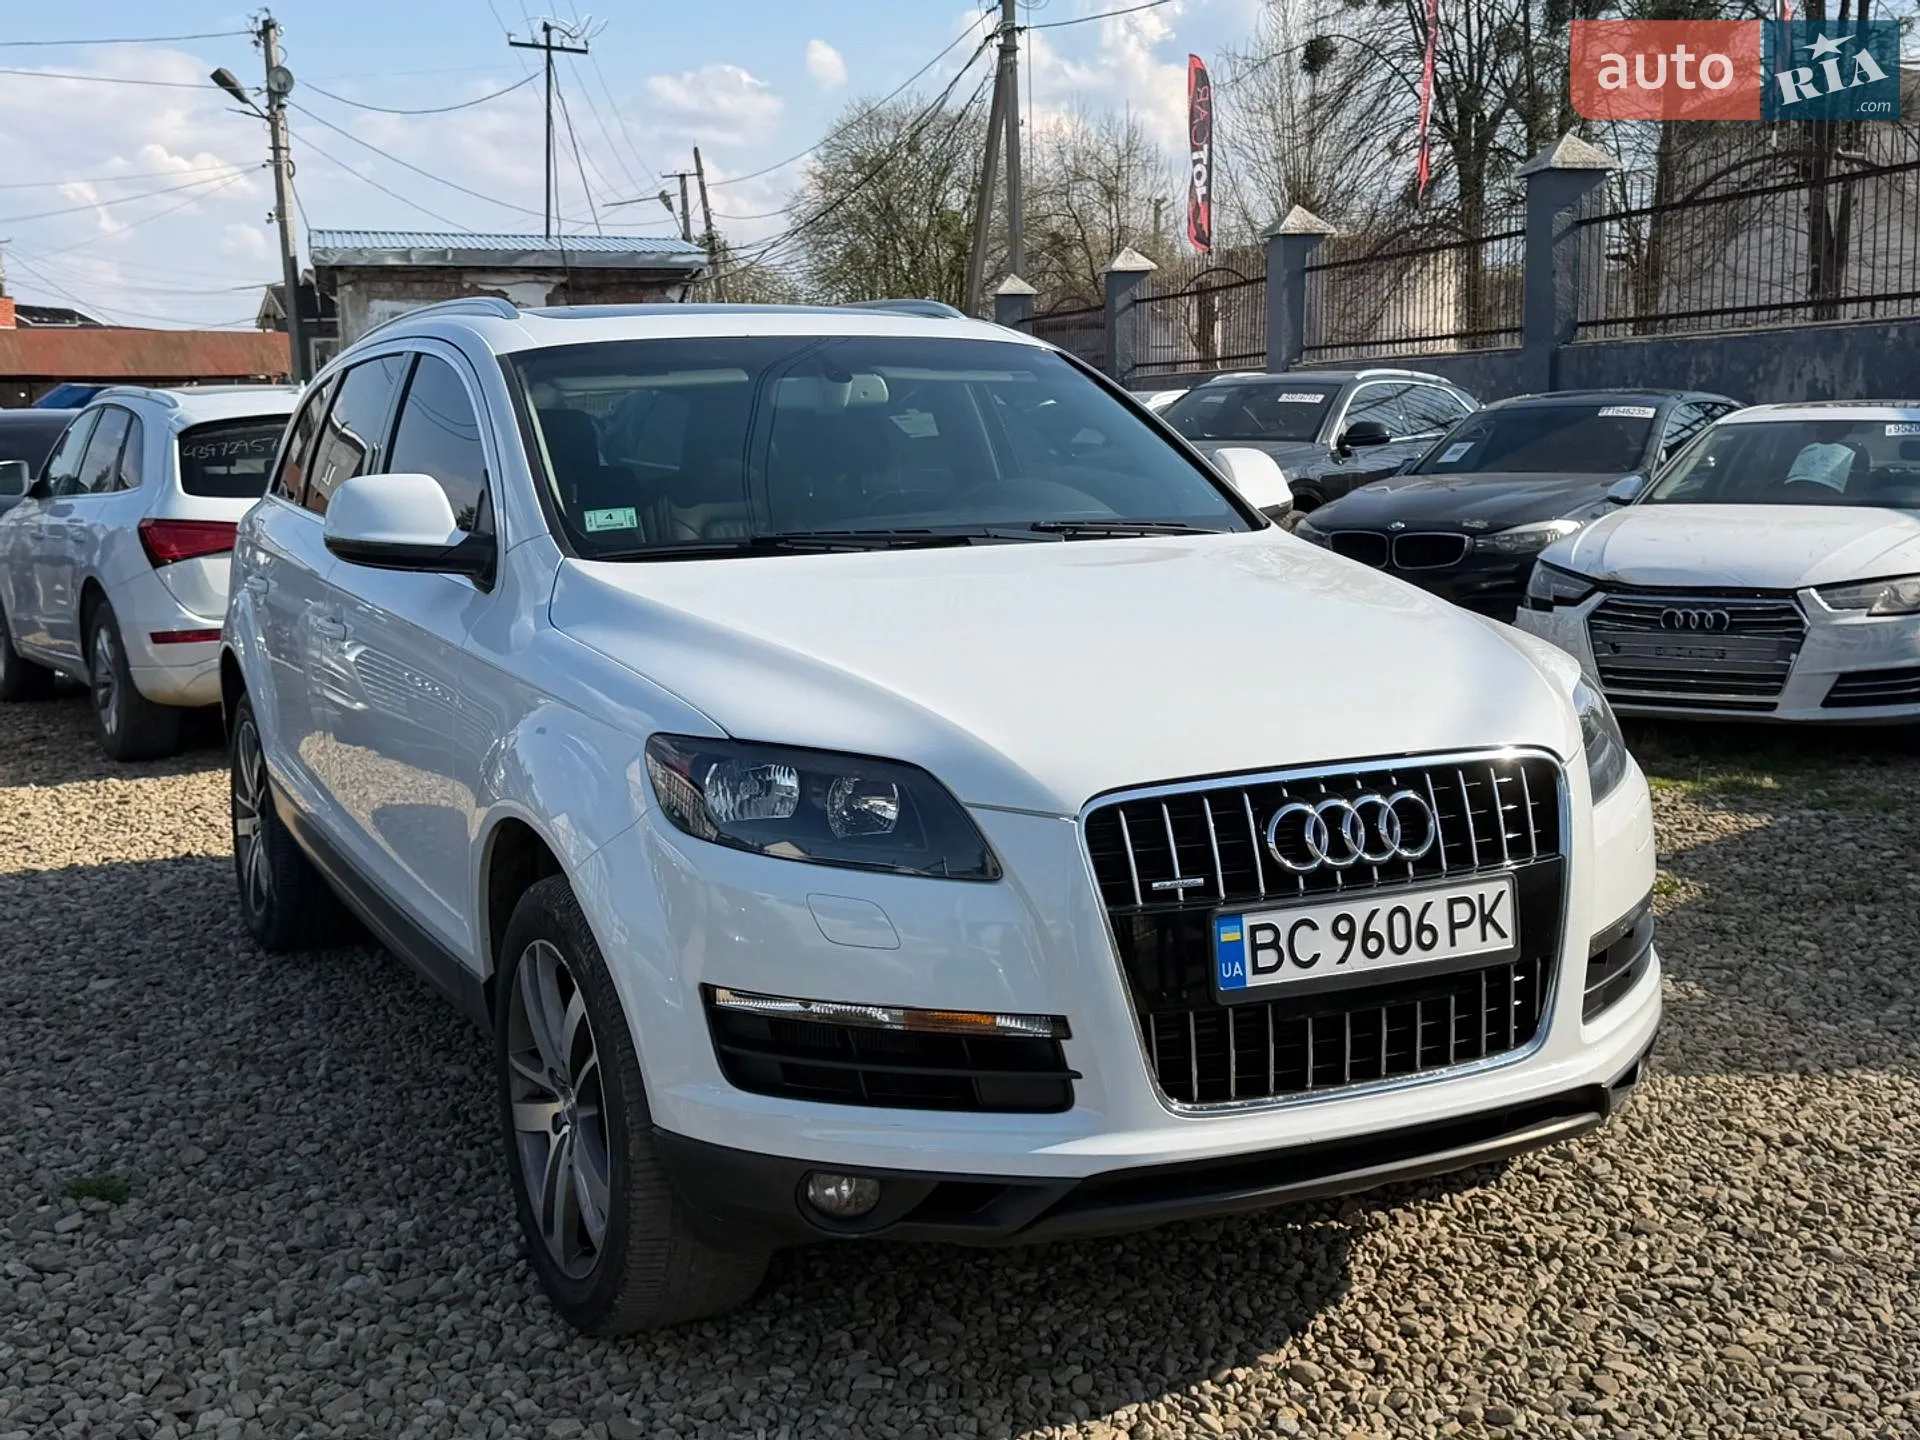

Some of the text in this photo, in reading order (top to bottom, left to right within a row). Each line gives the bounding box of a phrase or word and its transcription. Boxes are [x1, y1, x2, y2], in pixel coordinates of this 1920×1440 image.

[1249, 889, 1509, 976] BC 9606 PK
[1221, 963, 1243, 978] UA
